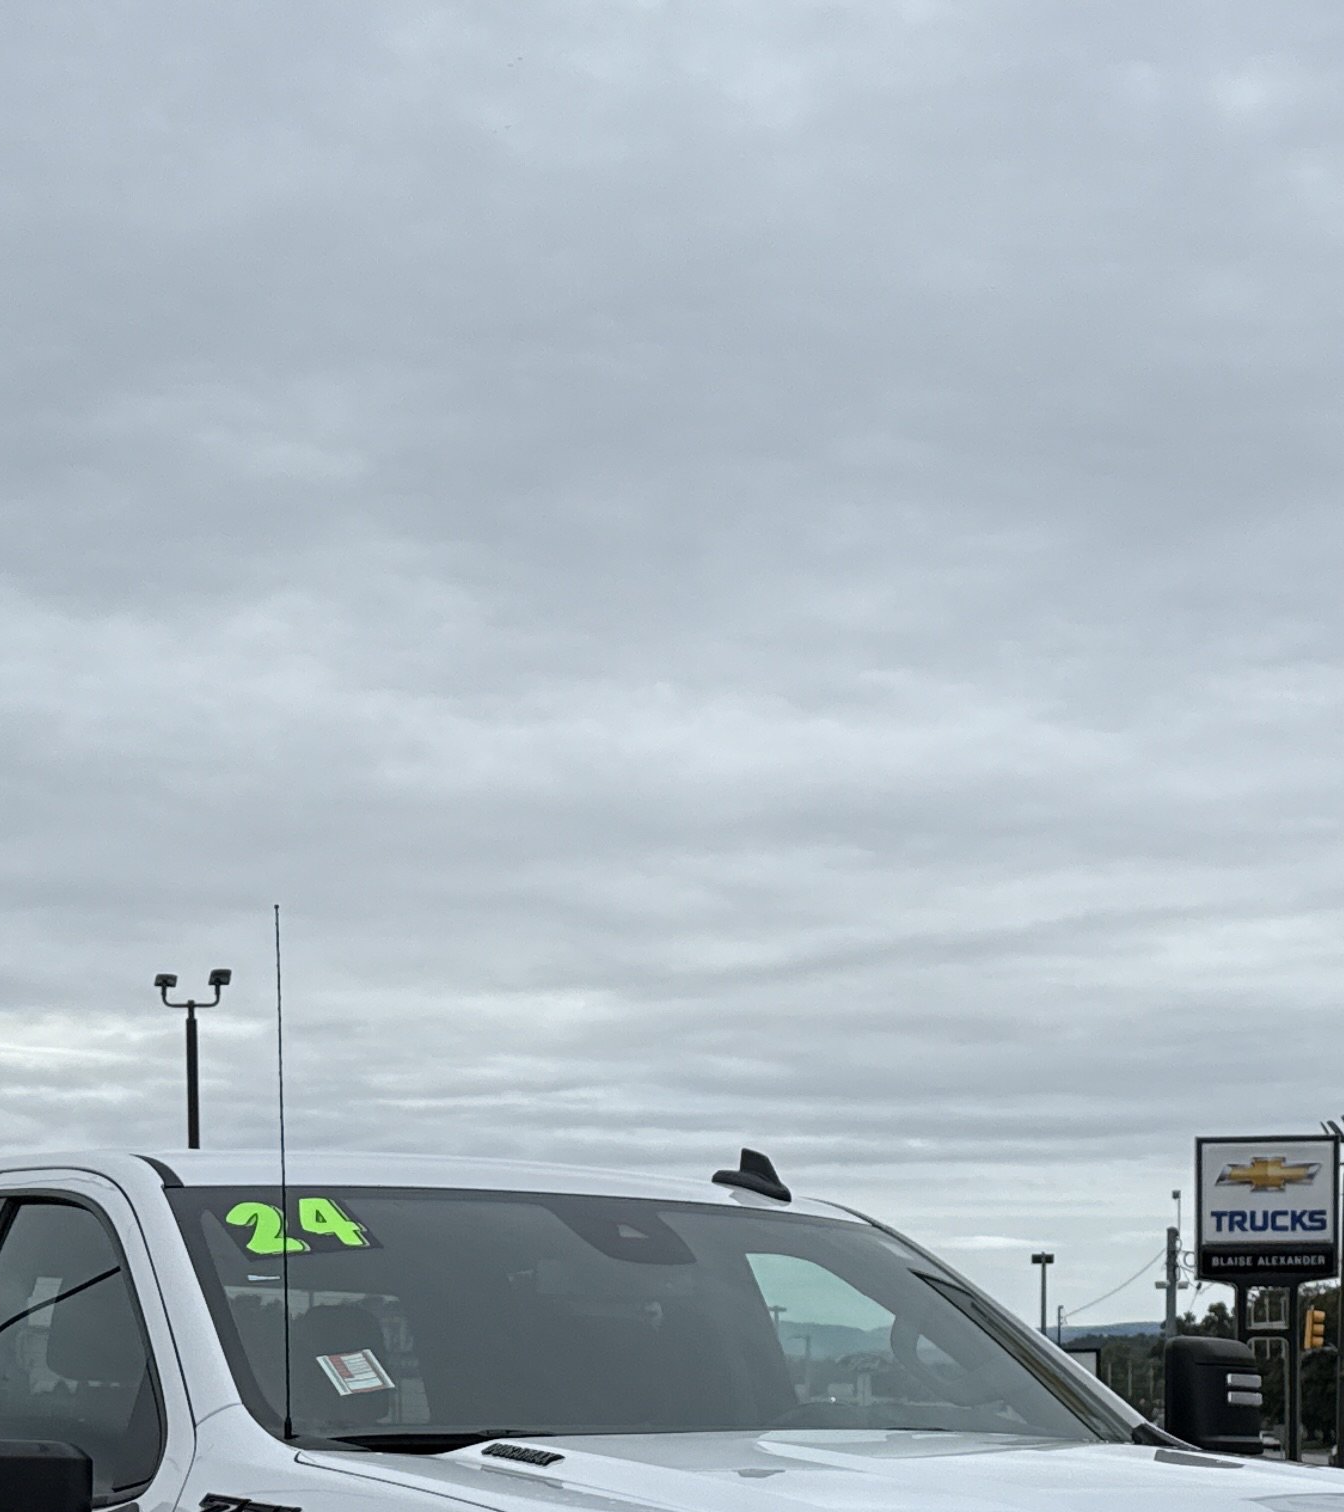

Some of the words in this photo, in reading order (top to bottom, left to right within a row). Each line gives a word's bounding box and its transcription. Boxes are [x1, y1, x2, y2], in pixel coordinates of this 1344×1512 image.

[225, 1196, 368, 1255] 24
[1210, 1209, 1328, 1232] TRUCKS
[1211, 1255, 1253, 1267] BLAISE
[1257, 1254, 1326, 1266] ALEXANDER
